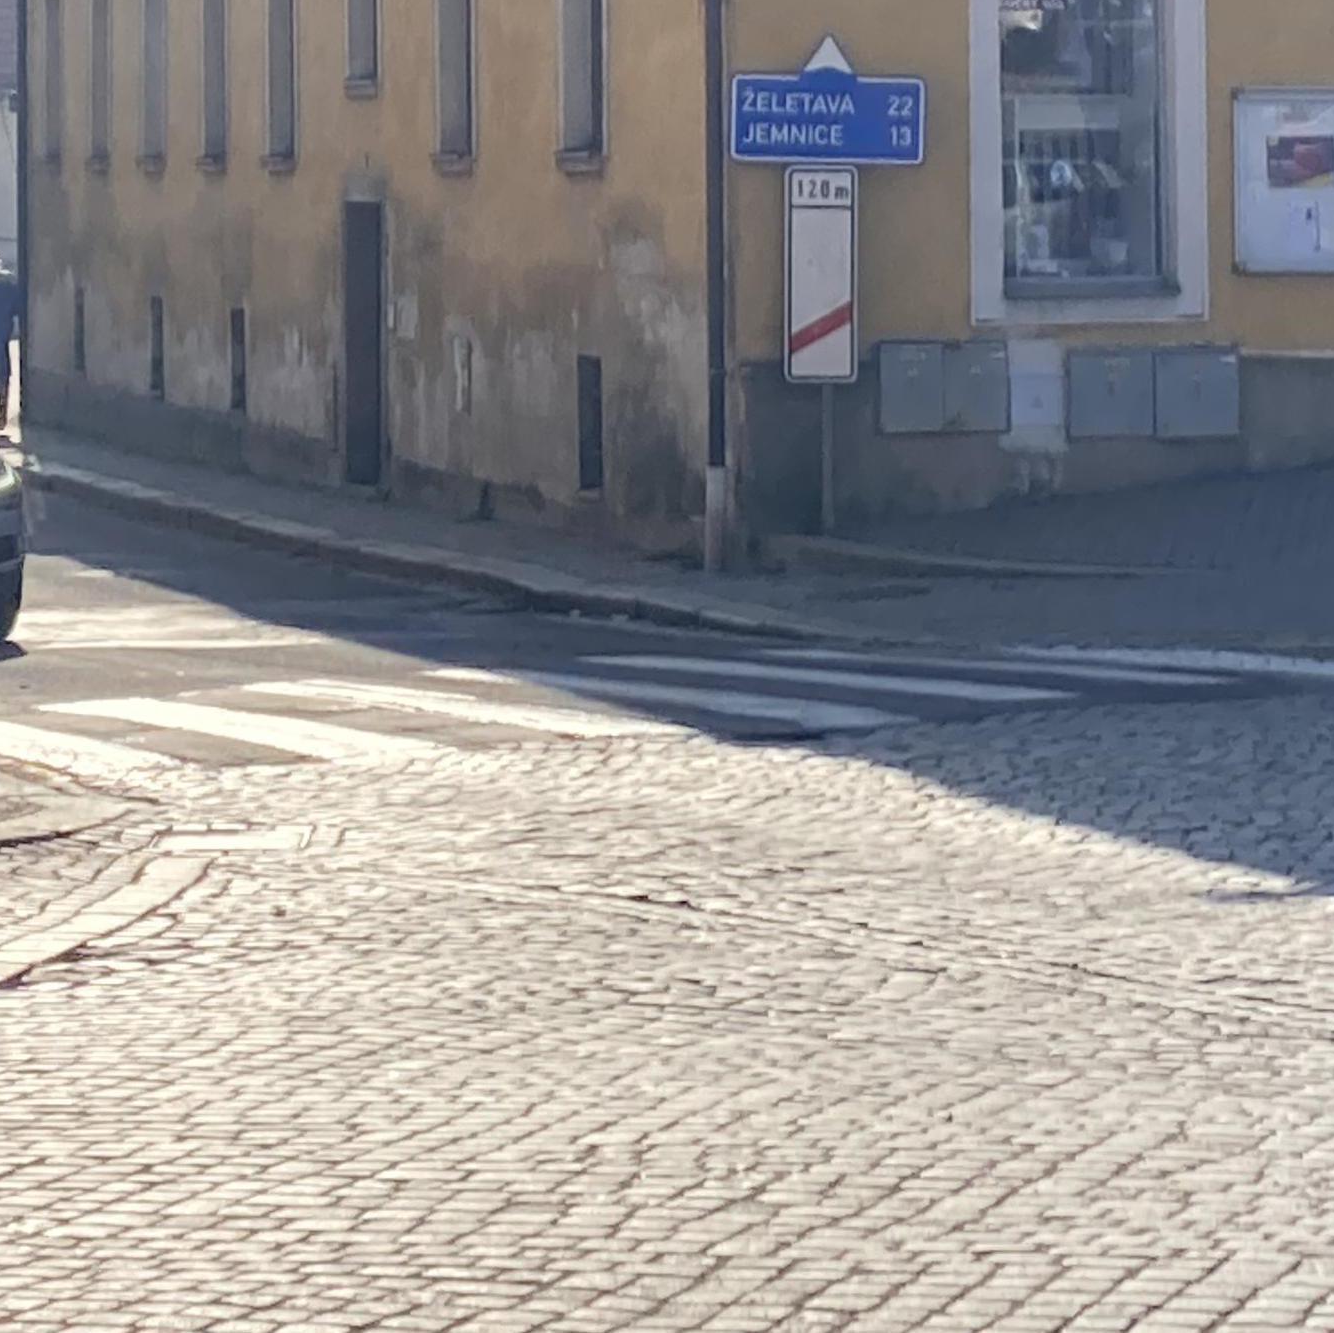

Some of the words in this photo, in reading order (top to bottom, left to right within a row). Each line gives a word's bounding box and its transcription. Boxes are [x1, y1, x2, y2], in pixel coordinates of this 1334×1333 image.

[741, 86, 855, 115] ŽELETAVA
[886, 94, 914, 116] 22
[742, 122, 845, 146] JEMNICE
[889, 125, 913, 146] 13
[797, 179, 831, 198] 120
[833, 185, 849, 200] m
